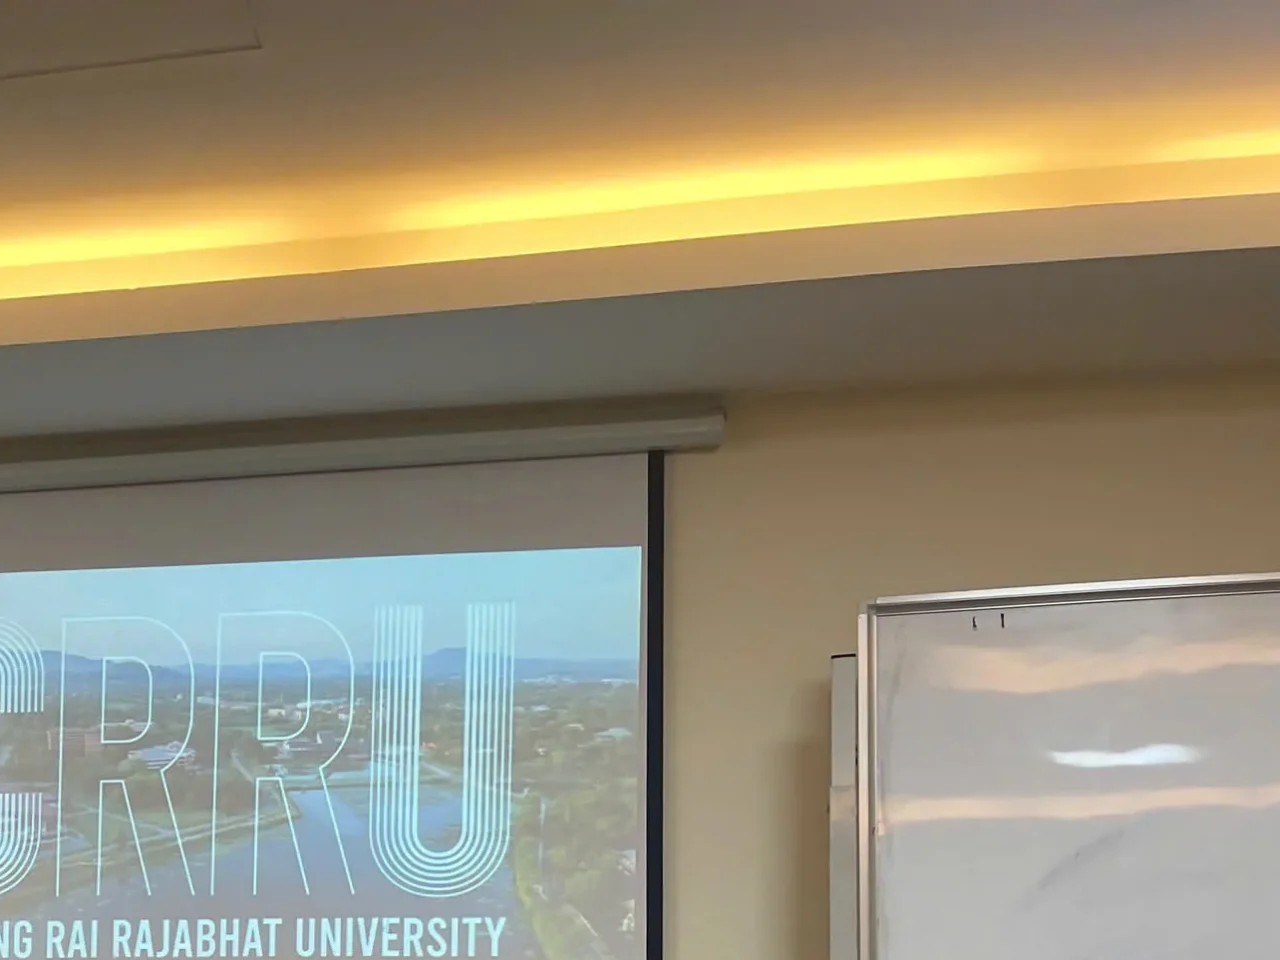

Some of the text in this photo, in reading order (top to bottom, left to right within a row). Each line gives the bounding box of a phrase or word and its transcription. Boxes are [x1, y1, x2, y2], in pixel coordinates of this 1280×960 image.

[46, 920, 98, 959] RAI
[112, 918, 282, 959] RAJABHAT
[296, 917, 507, 957] UNIVERSITY
